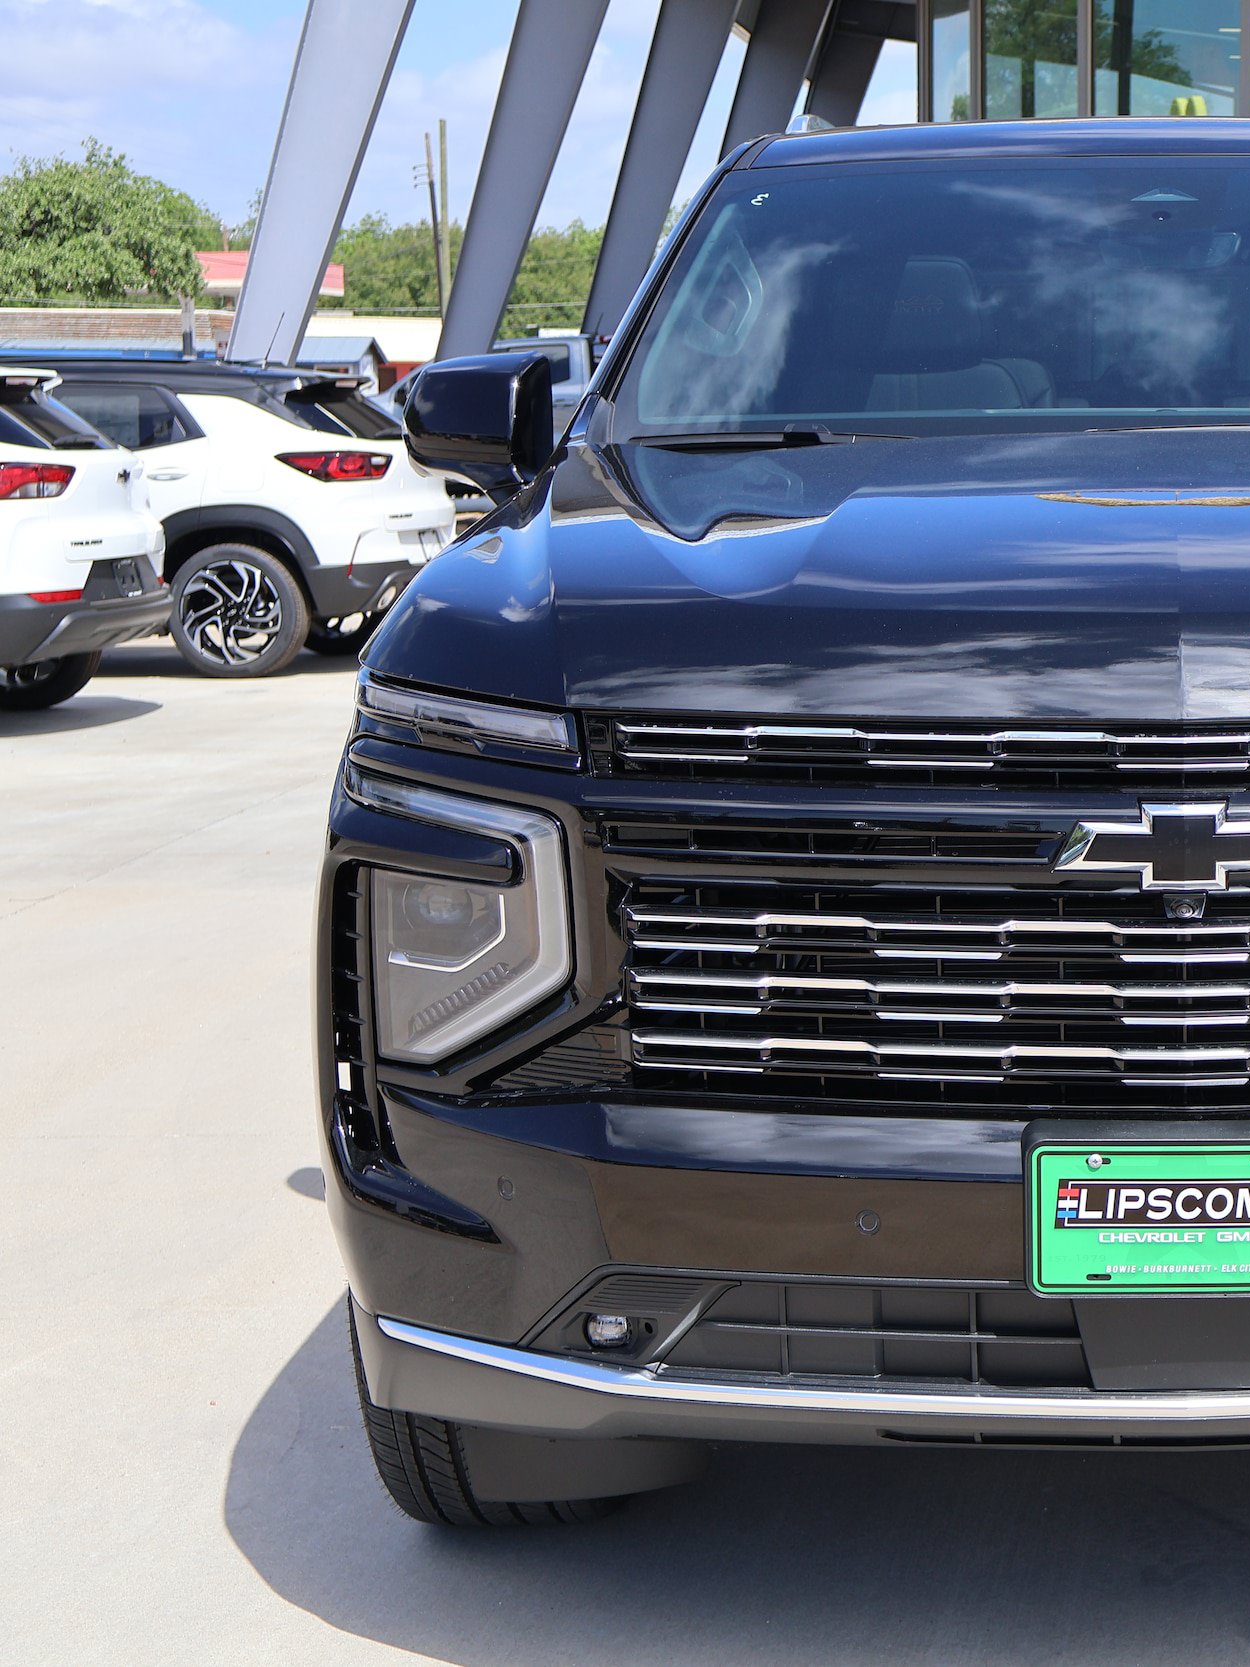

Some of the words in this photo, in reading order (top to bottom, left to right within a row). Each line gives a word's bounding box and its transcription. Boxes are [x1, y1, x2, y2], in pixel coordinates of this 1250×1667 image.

[1098, 1231, 1206, 1244] CHEVROLET
[1105, 1264, 1137, 1274] BOWIE
[1143, 1264, 1212, 1274] BURKBURNETT
[1221, 1263, 1238, 1273] ELK
